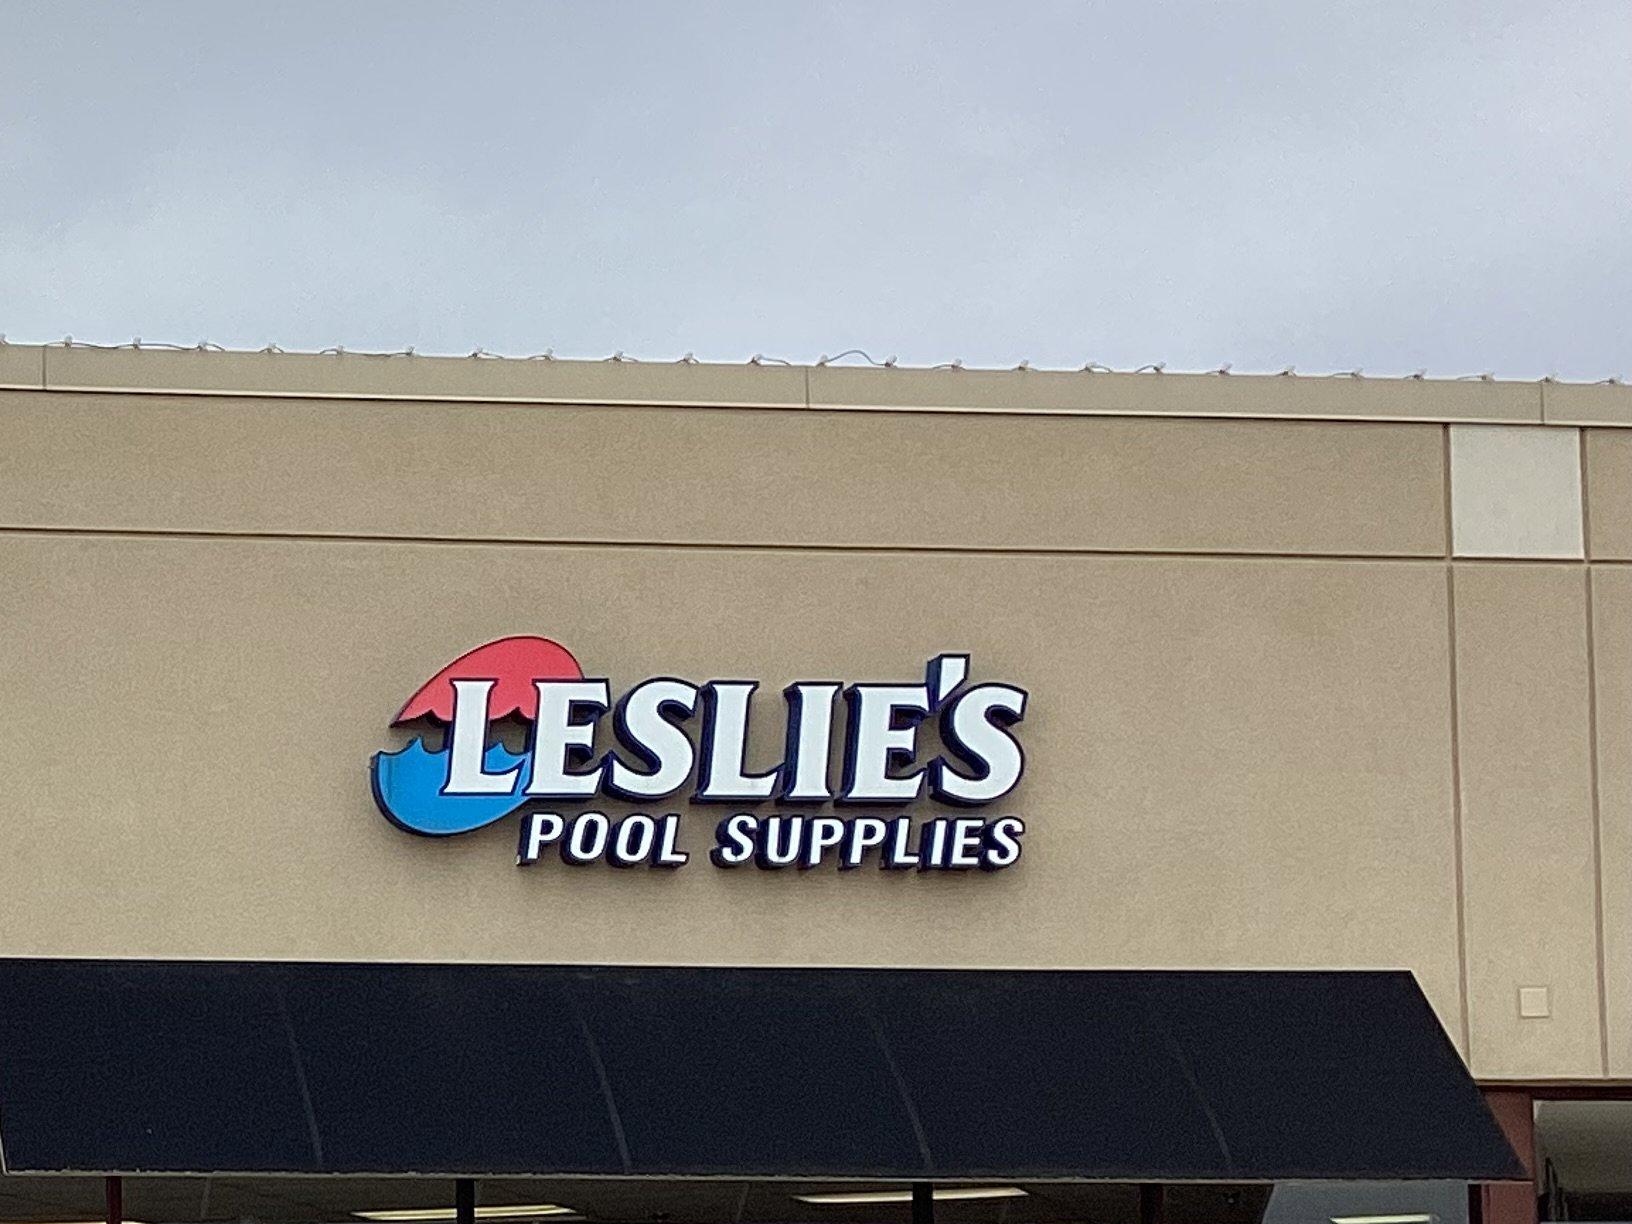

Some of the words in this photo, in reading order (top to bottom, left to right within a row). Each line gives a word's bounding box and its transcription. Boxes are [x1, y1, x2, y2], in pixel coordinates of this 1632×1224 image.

[444, 653, 1029, 804] LESLIE'S
[518, 811, 690, 867] POOL
[711, 814, 1027, 868] SUPPLIES
